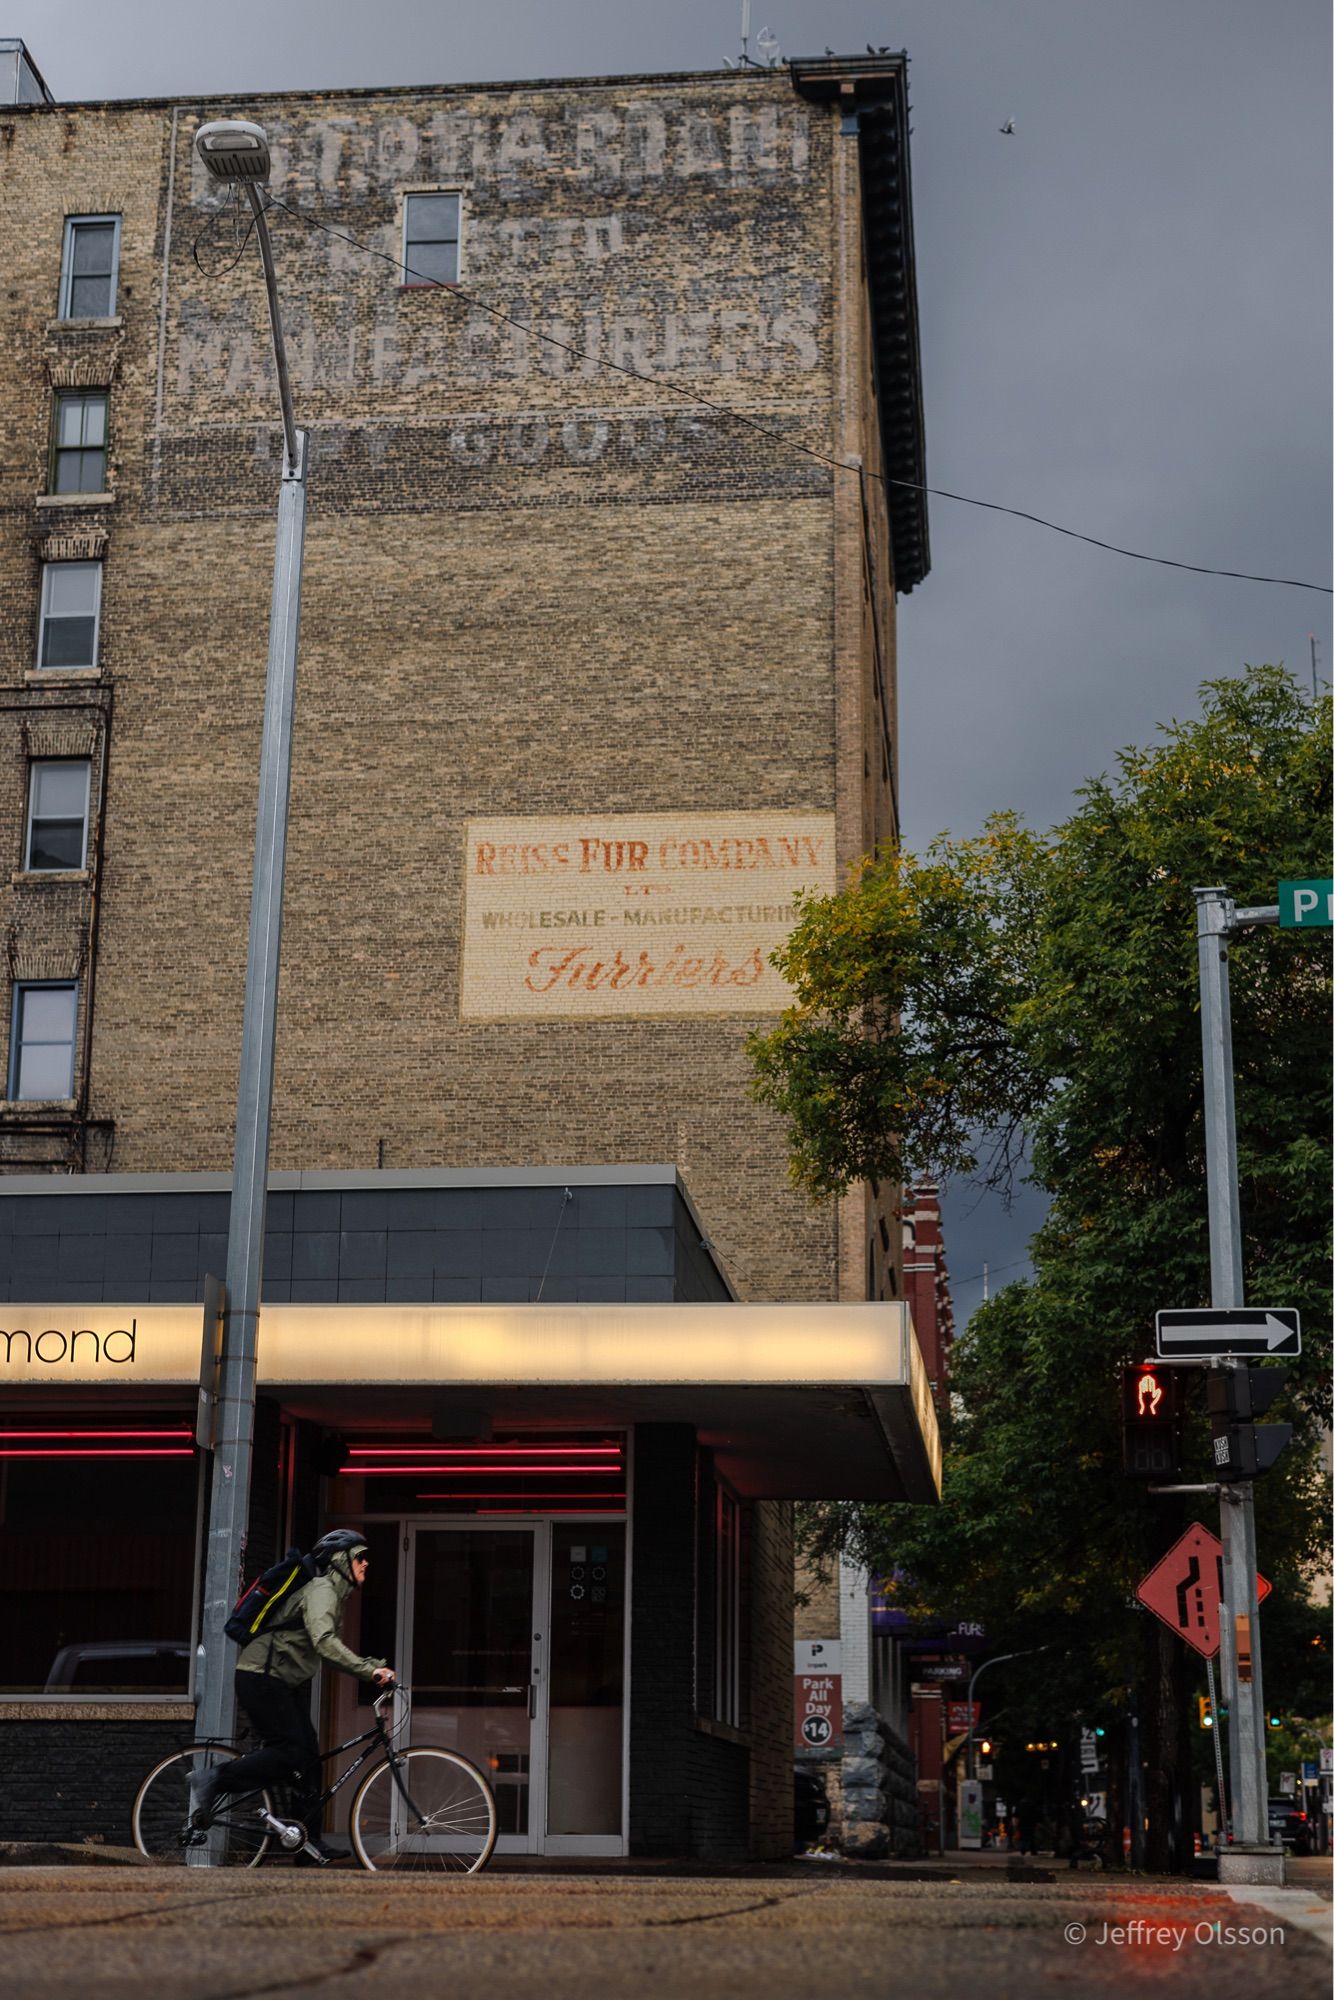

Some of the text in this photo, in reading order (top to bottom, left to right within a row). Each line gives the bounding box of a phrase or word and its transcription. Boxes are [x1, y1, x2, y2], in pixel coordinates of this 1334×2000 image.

[474, 836, 823, 875] REISS FUR COMPANY
[524, 944, 763, 993] Furriers
[803, 1678, 833, 1690] Park
[809, 1690, 828, 1702] All
[805, 1702, 832, 1716] Day
[804, 1722, 828, 1737] $14
